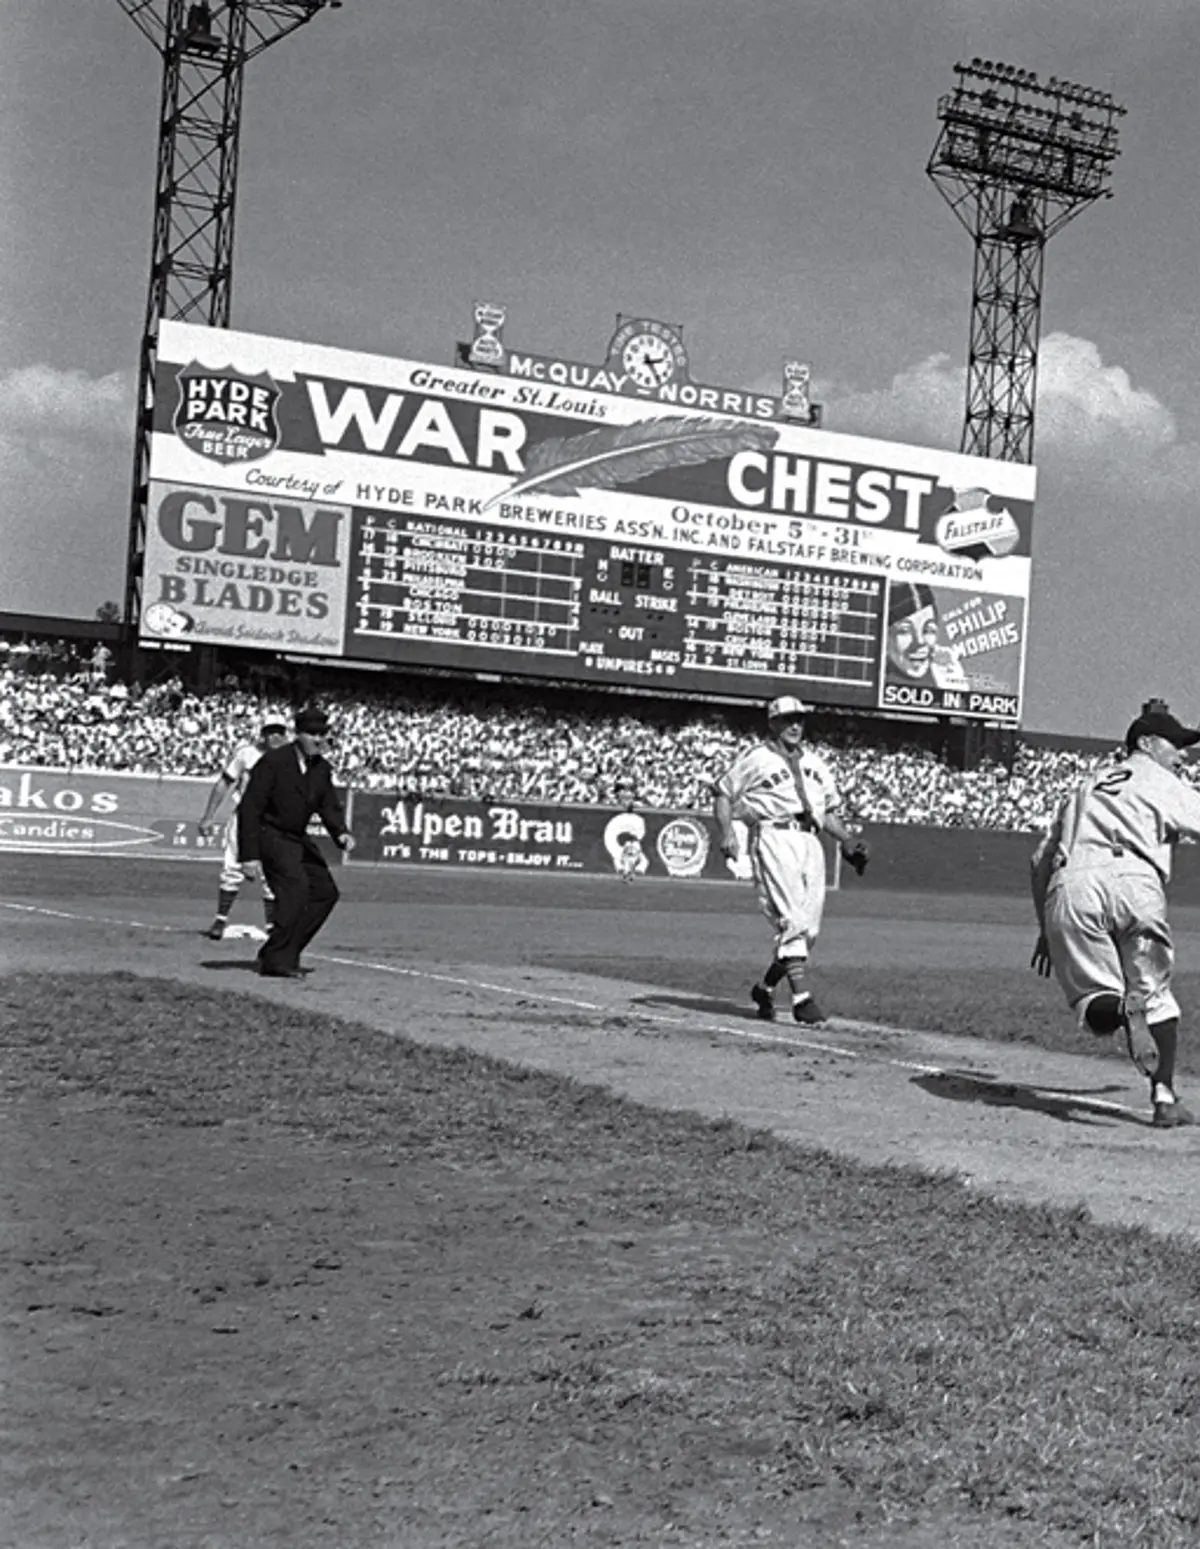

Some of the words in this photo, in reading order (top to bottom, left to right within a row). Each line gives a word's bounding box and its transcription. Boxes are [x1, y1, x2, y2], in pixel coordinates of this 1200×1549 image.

[188, 378, 270, 411] HYDE
[409, 368, 506, 400] Greater
[510, 355, 629, 393] McQUAY
[659, 382, 775, 417] NORRIS
[186, 400, 268, 432] PARK
[305, 380, 528, 473] WAR
[202, 440, 250, 459] BEER
[727, 450, 933, 531] CHEST
[157, 490, 345, 568] GEM
[245, 468, 320, 501] Courtesy
[323, 479, 345, 496] of
[356, 483, 415, 507] HYDE
[423, 491, 483, 516] PARK
[498, 503, 609, 532] BREWERIES
[706, 531, 742, 550] AND
[748, 537, 827, 561] FALSTAFF
[829, 547, 892, 571] BREWING
[895, 556, 984, 583] CORPORATION
[670, 505, 778, 536] October
[943, 517, 1005, 541] FALSTAFF
[609, 545, 665, 566] BATTER
[175, 555, 320, 589] SINGLEDGE
[157, 573, 330, 620] BLADES
[589, 587, 623, 606] BALL
[634, 594, 679, 613] STRIKE
[618, 625, 646, 641] OUT
[945, 599, 1007, 641] PHILIP
[951, 622, 1019, 659] MORRIS
[885, 685, 934, 706] SOLD
[943, 692, 961, 709] IN
[969, 694, 1017, 714] PARK
[1092, 769, 1134, 797] 2
[0, 818, 95, 839] Candies
[379, 800, 484, 846] Alpen
[487, 806, 573, 844] Brau
[382, 843, 412, 859] IT'S
[418, 847, 450, 861] THE
